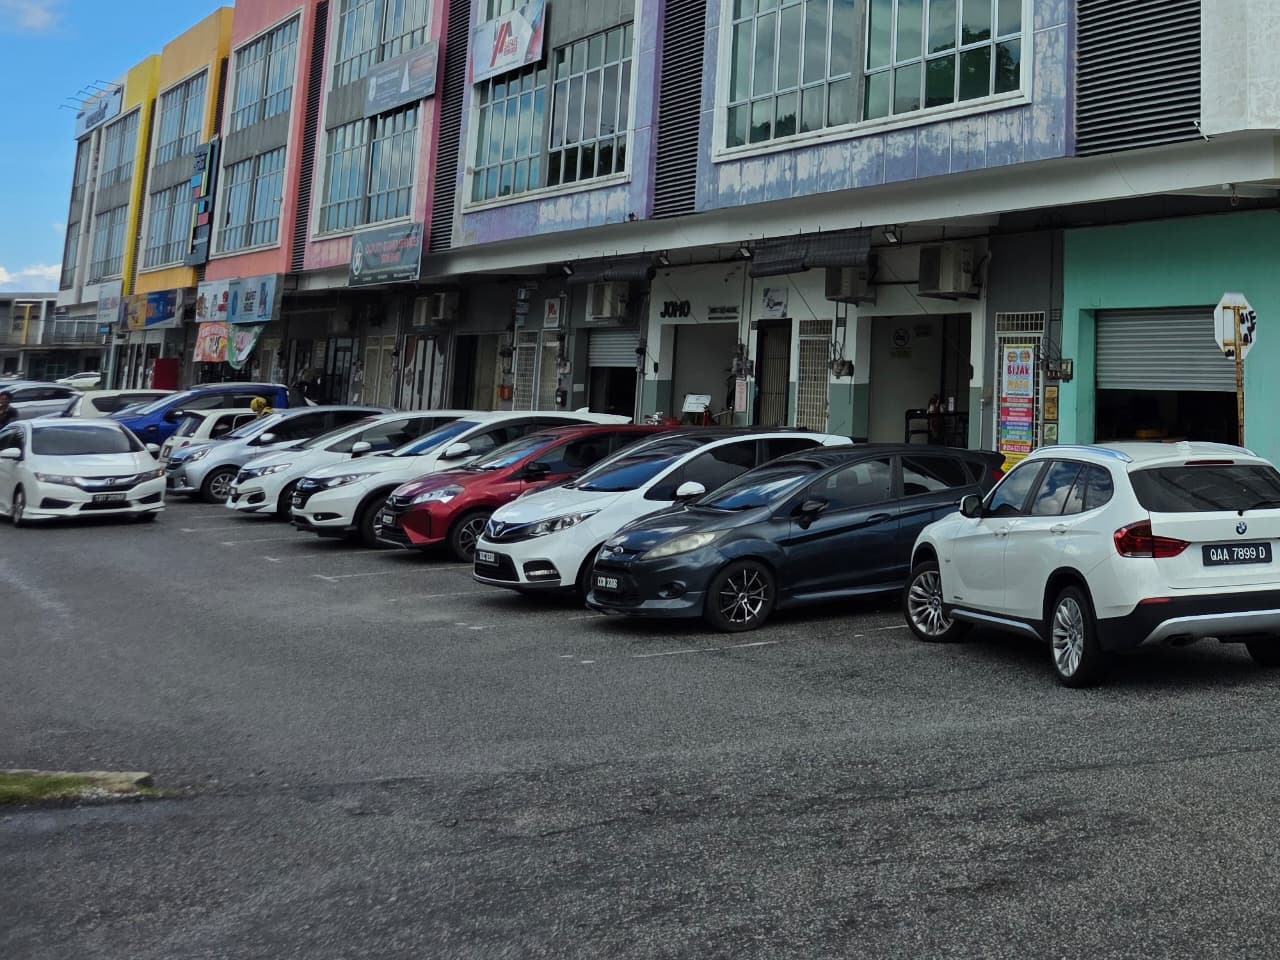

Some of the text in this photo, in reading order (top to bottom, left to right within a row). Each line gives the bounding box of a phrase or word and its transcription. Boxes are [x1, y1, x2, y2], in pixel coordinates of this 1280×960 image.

[660, 300, 691, 318] JOMO
[1007, 364, 1030, 375] BIJAK
[1210, 547, 1266, 560] QAA 7899 D
